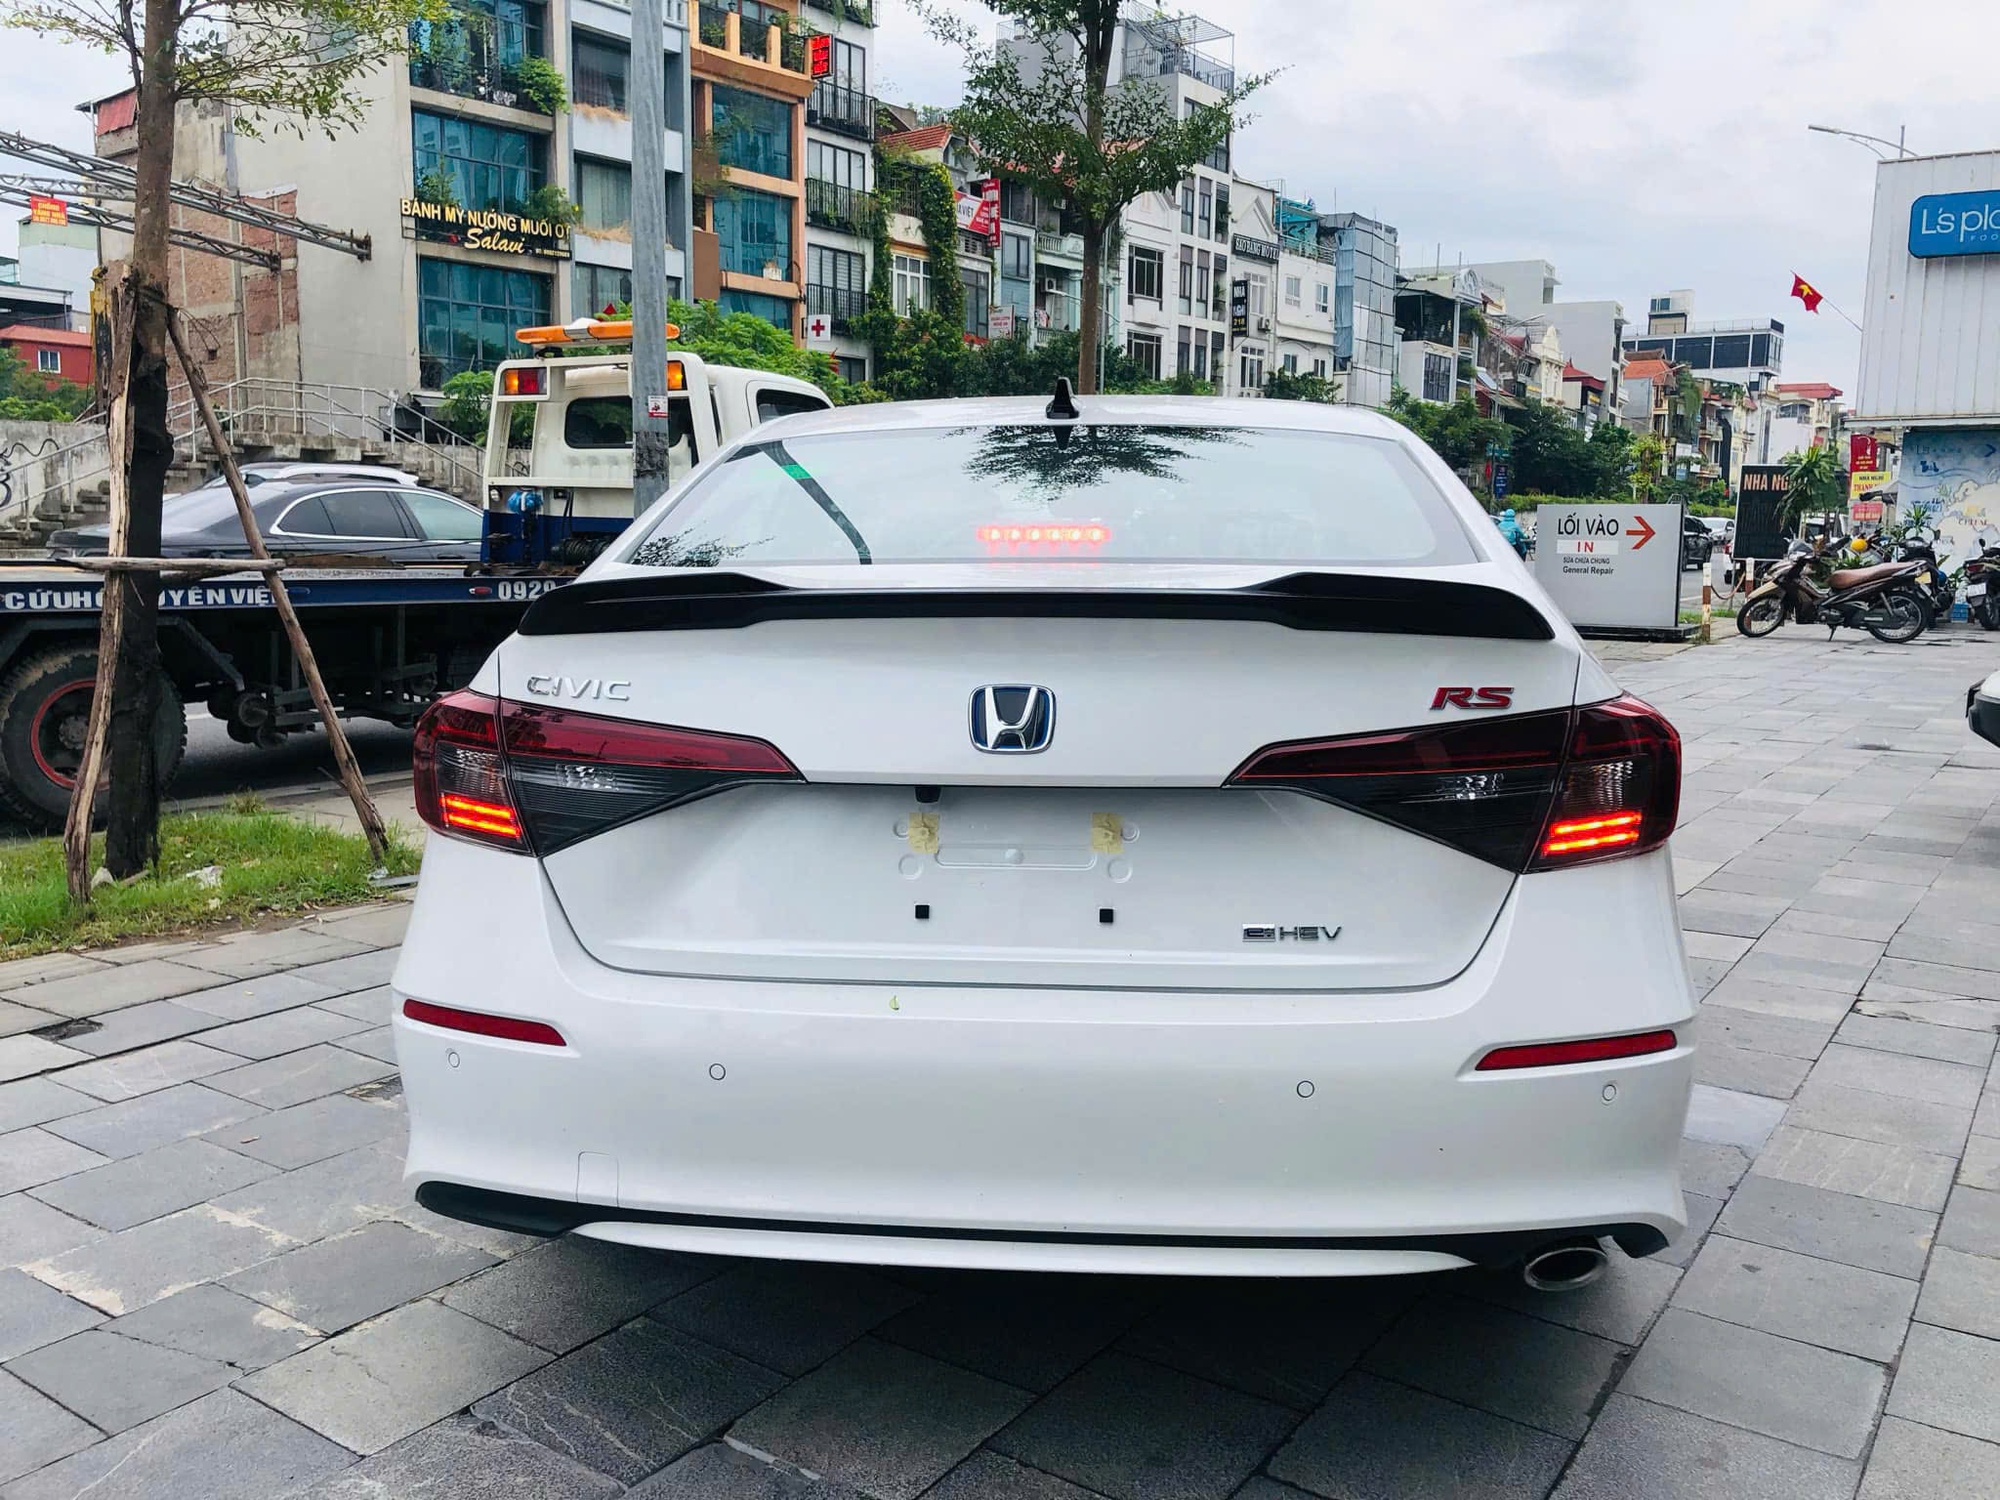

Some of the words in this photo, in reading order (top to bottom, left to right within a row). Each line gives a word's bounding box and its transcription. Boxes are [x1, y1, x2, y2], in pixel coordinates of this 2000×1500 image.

[401, 198, 441, 220] BÁNH
[468, 209, 517, 232] NƯỚNG
[520, 218, 552, 238] MUỐI
[1922, 207, 1955, 235] L's
[464, 228, 526, 254] Salavi
[1558, 512, 1579, 535] LỐI
[1586, 514, 1619, 536] VÀO
[1577, 541, 1594, 553] IN
[1562, 566, 1589, 574] General
[1591, 566, 1614, 576] Repair
[527, 675, 631, 702] CIVIC
[1430, 686, 1514, 710] RS
